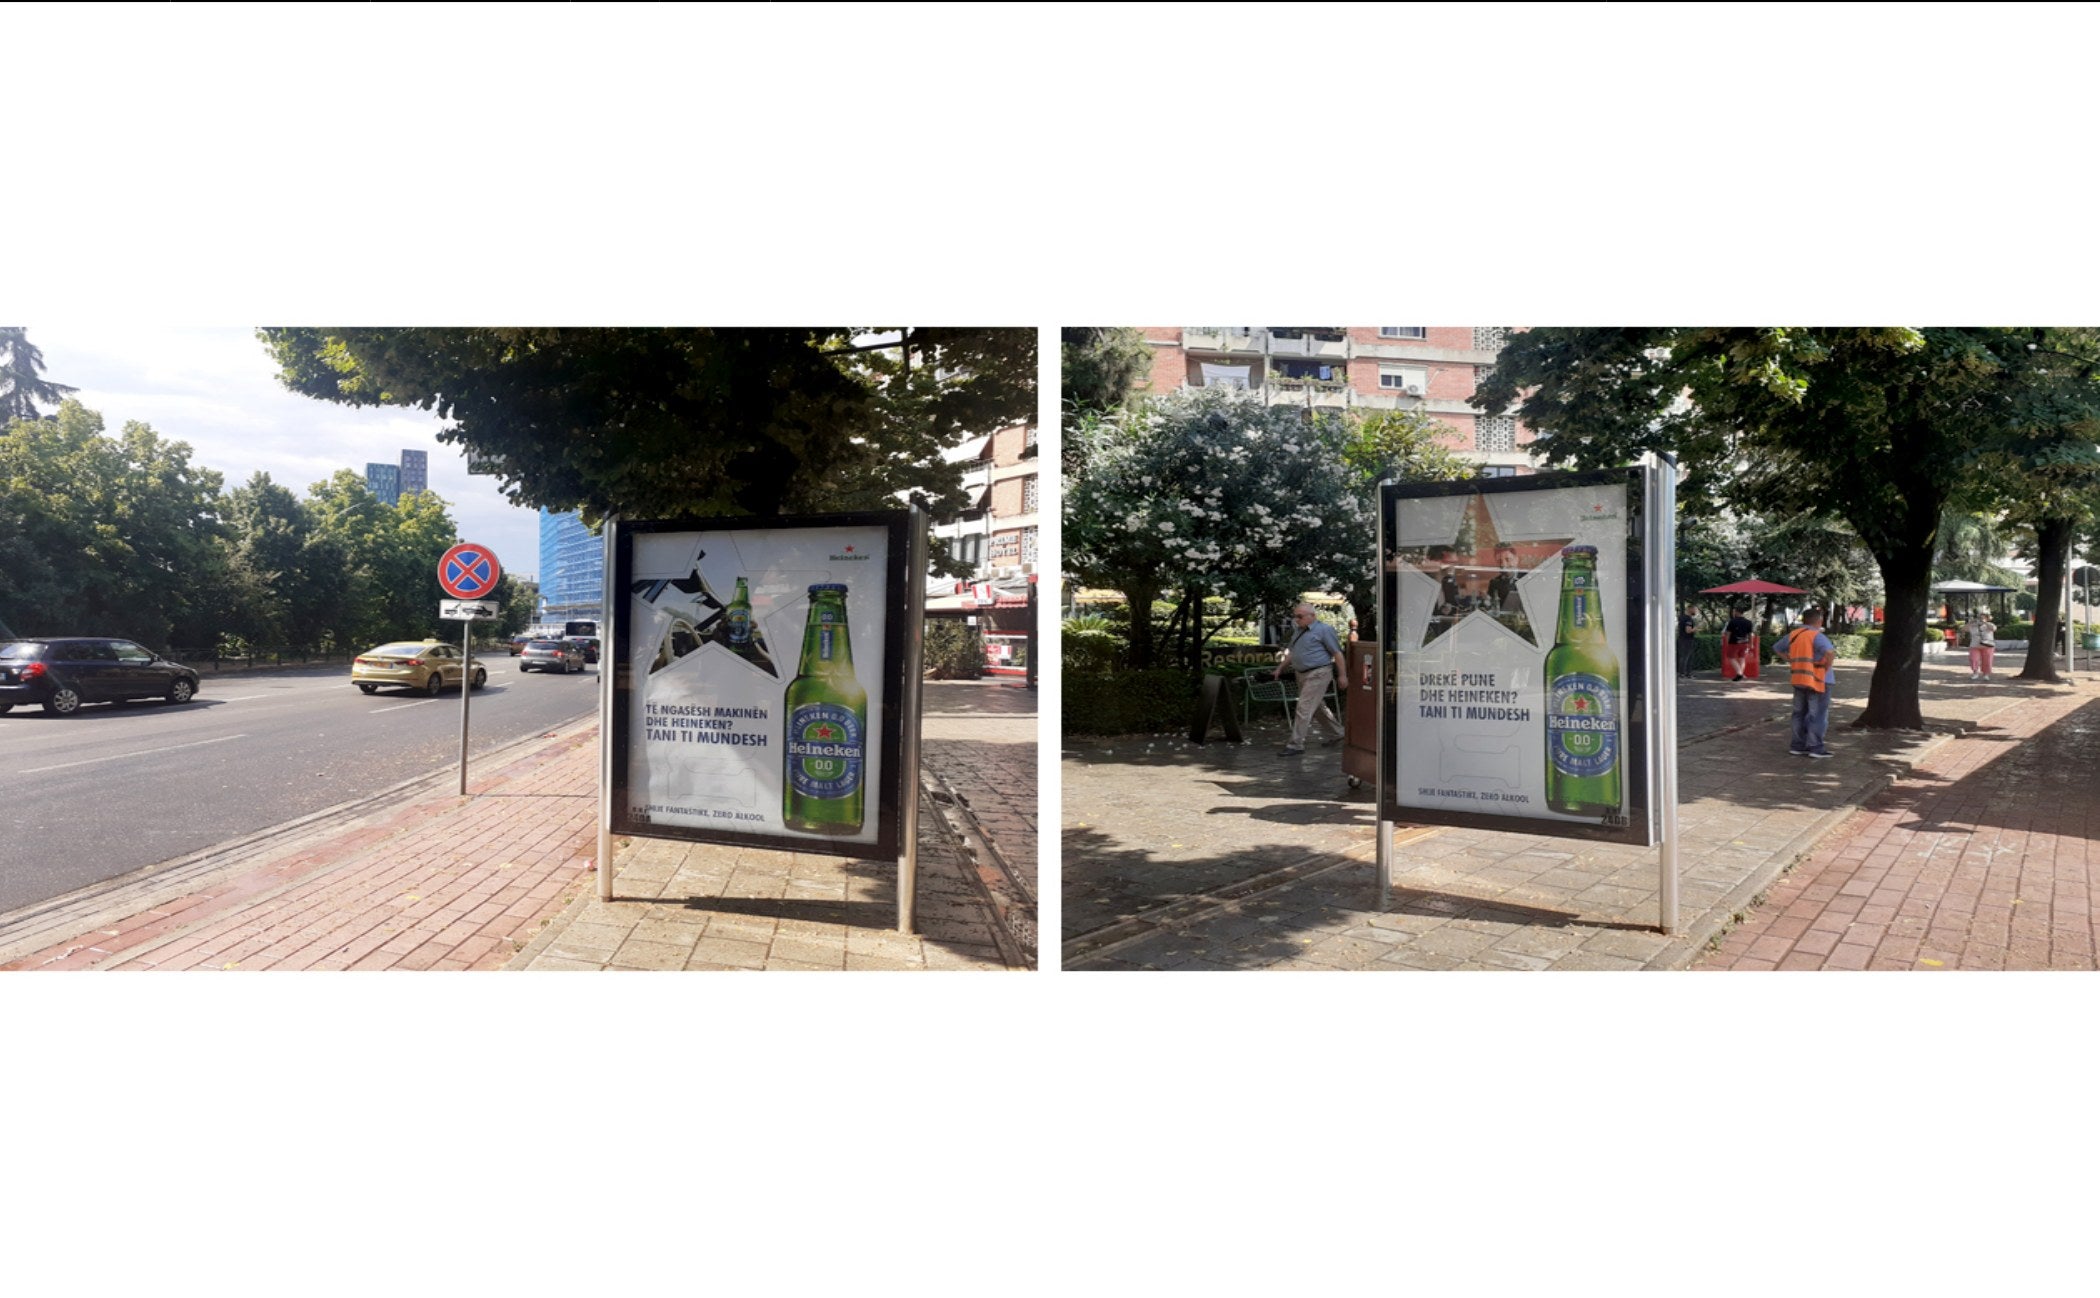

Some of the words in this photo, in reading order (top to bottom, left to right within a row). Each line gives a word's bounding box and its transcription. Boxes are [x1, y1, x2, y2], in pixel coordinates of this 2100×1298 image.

[1420, 670, 1458, 686] DREKË
[1461, 673, 1496, 687] PUNE
[1420, 689, 1444, 702] DHE
[1448, 690, 1518, 704] HEINEKEN?
[646, 702, 657, 714] TË
[661, 703, 711, 717] NGASËSH
[714, 705, 768, 719] MAKINËN
[1419, 705, 1447, 718] TANI
[1451, 706, 1462, 719] TI
[1466, 706, 1530, 721] MUNDESH
[646, 716, 668, 727] DHE
[672, 717, 734, 730] HEINEKEN?
[1549, 715, 1616, 731] Heineken
[646, 728, 676, 741] TANI
[681, 730, 692, 742] TI
[697, 731, 768, 746] MUNDESH
[788, 742, 861, 758] Heineken
